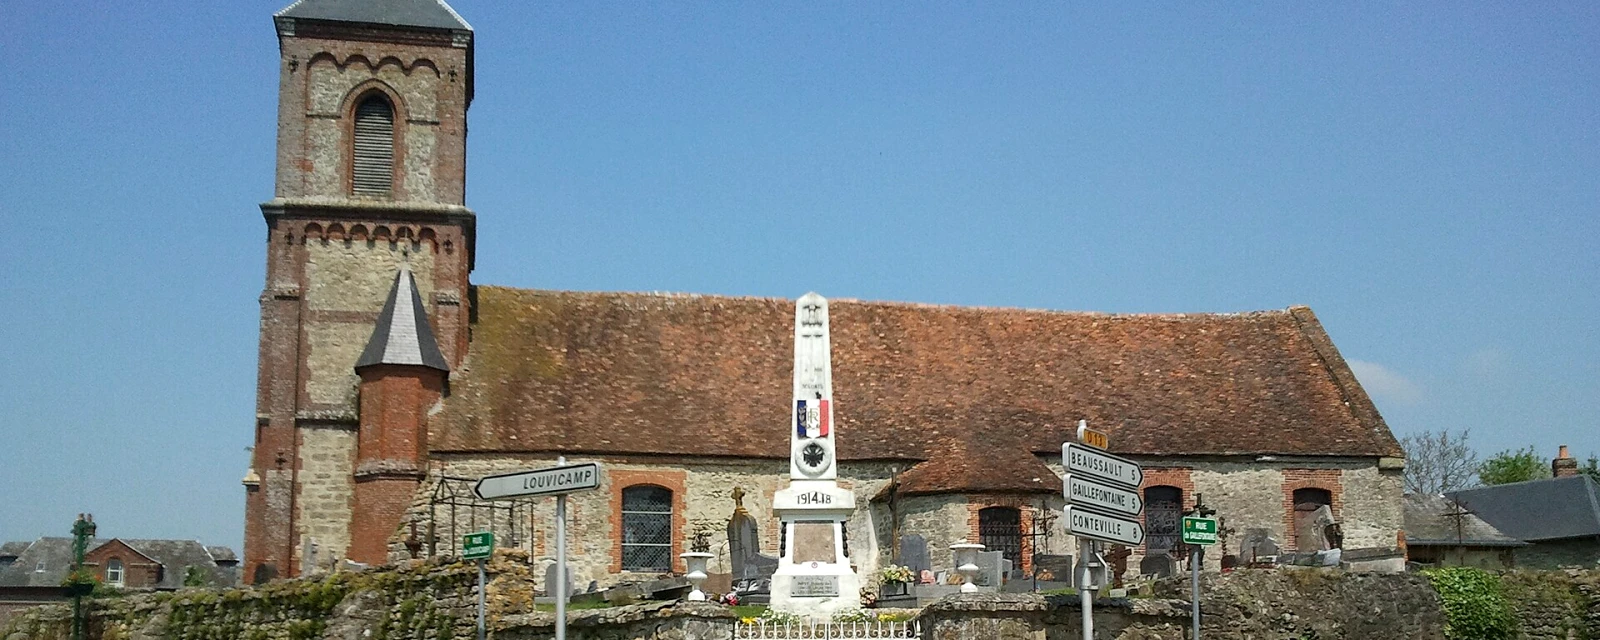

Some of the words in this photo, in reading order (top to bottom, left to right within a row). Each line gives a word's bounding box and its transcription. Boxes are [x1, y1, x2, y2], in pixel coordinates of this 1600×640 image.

[1071, 452, 1122, 477] BEAUSSAULT
[1131, 469, 1136, 481] 5
[523, 470, 592, 490] LOUVICAMP
[1072, 483, 1125, 507] GAILLEFONTAINE
[1131, 498, 1136, 510] 5
[1073, 514, 1121, 536] CONTEVILLE
[1132, 527, 1137, 539] 8
[1195, 521, 1207, 530] RUE
[472, 536, 483, 544] RUE
